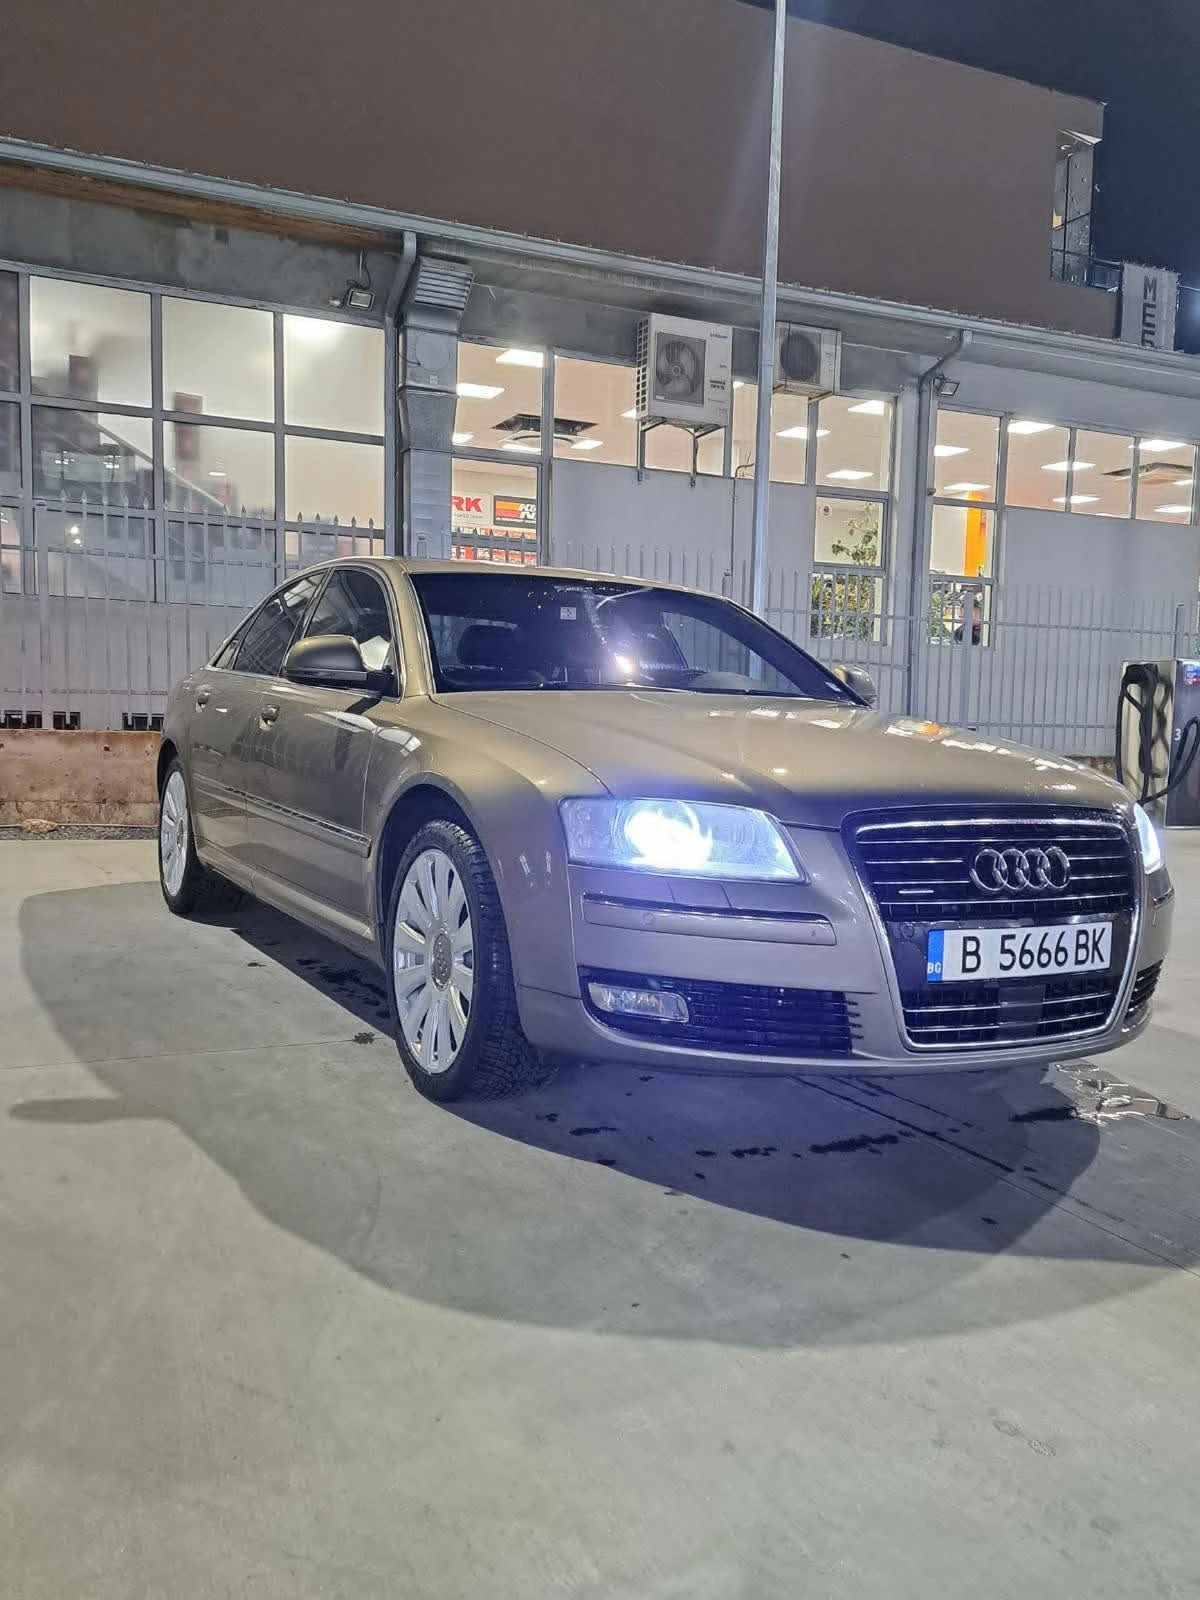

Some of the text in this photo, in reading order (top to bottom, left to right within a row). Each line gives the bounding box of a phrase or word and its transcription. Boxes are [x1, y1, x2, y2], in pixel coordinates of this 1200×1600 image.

[1174, 728, 1182, 741] 3
[961, 928, 1106, 973] B 5666 BK
[927, 962, 942, 974] BG
